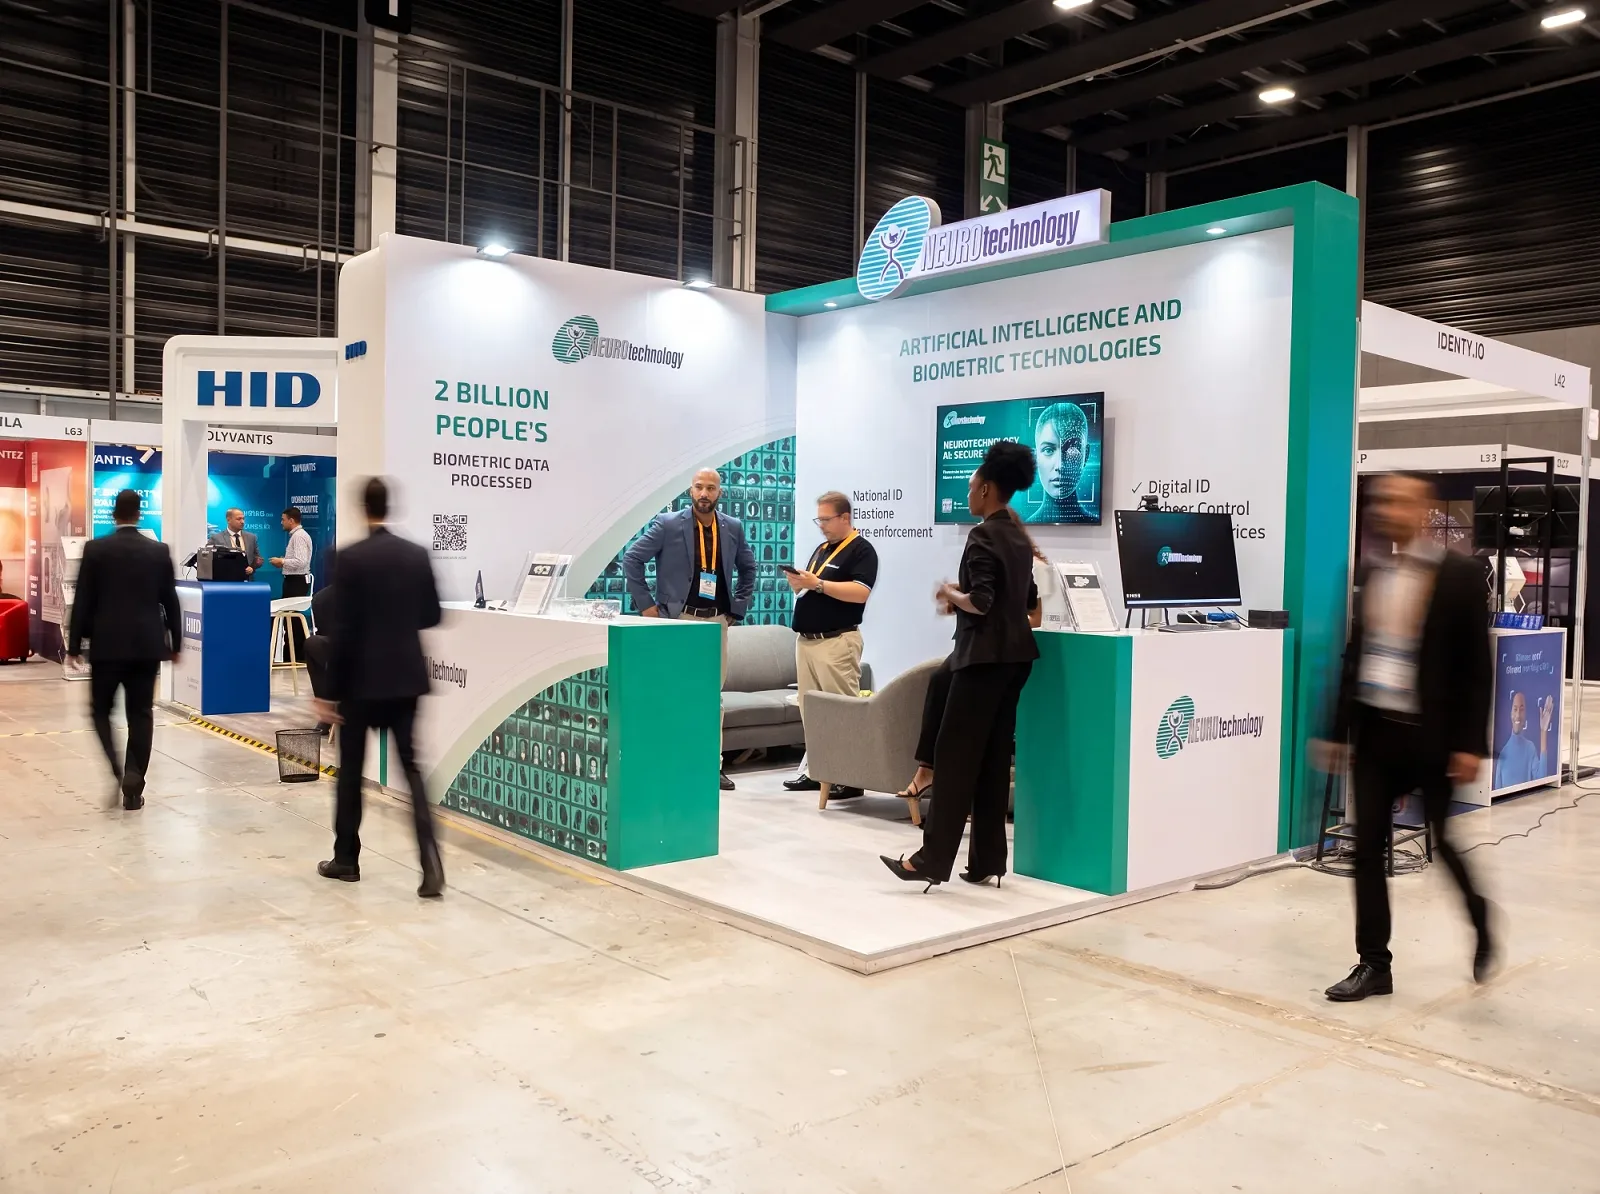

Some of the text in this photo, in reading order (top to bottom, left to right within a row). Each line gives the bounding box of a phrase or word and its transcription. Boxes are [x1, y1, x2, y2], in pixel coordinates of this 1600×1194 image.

[921, 210, 1081, 272] NEUROtechnology
[899, 299, 1182, 357] ARTIFICIAL INTELLIGENCE AND
[588, 336, 684, 370] NEUROtechnology
[1437, 331, 1485, 360] IDENTY.IO
[913, 334, 1161, 383] BIOMETRIC TECHNOLOGIES
[197, 370, 321, 408] HID
[1554, 372, 1566, 388] L42
[434, 379, 549, 410] 2 BILLION
[64, 427, 83, 436] L63
[436, 414, 548, 443] PEOPLE'S
[433, 452, 550, 472] BIOMETRIC DATA
[954, 449, 984, 459] SECURE
[1480, 453, 1497, 463] L33
[451, 473, 532, 490] PROCESSED
[1149, 479, 1211, 498] Digital ID
[853, 488, 903, 502] National ID
[853, 507, 895, 520] Elastione
[1197, 500, 1250, 516] Control
